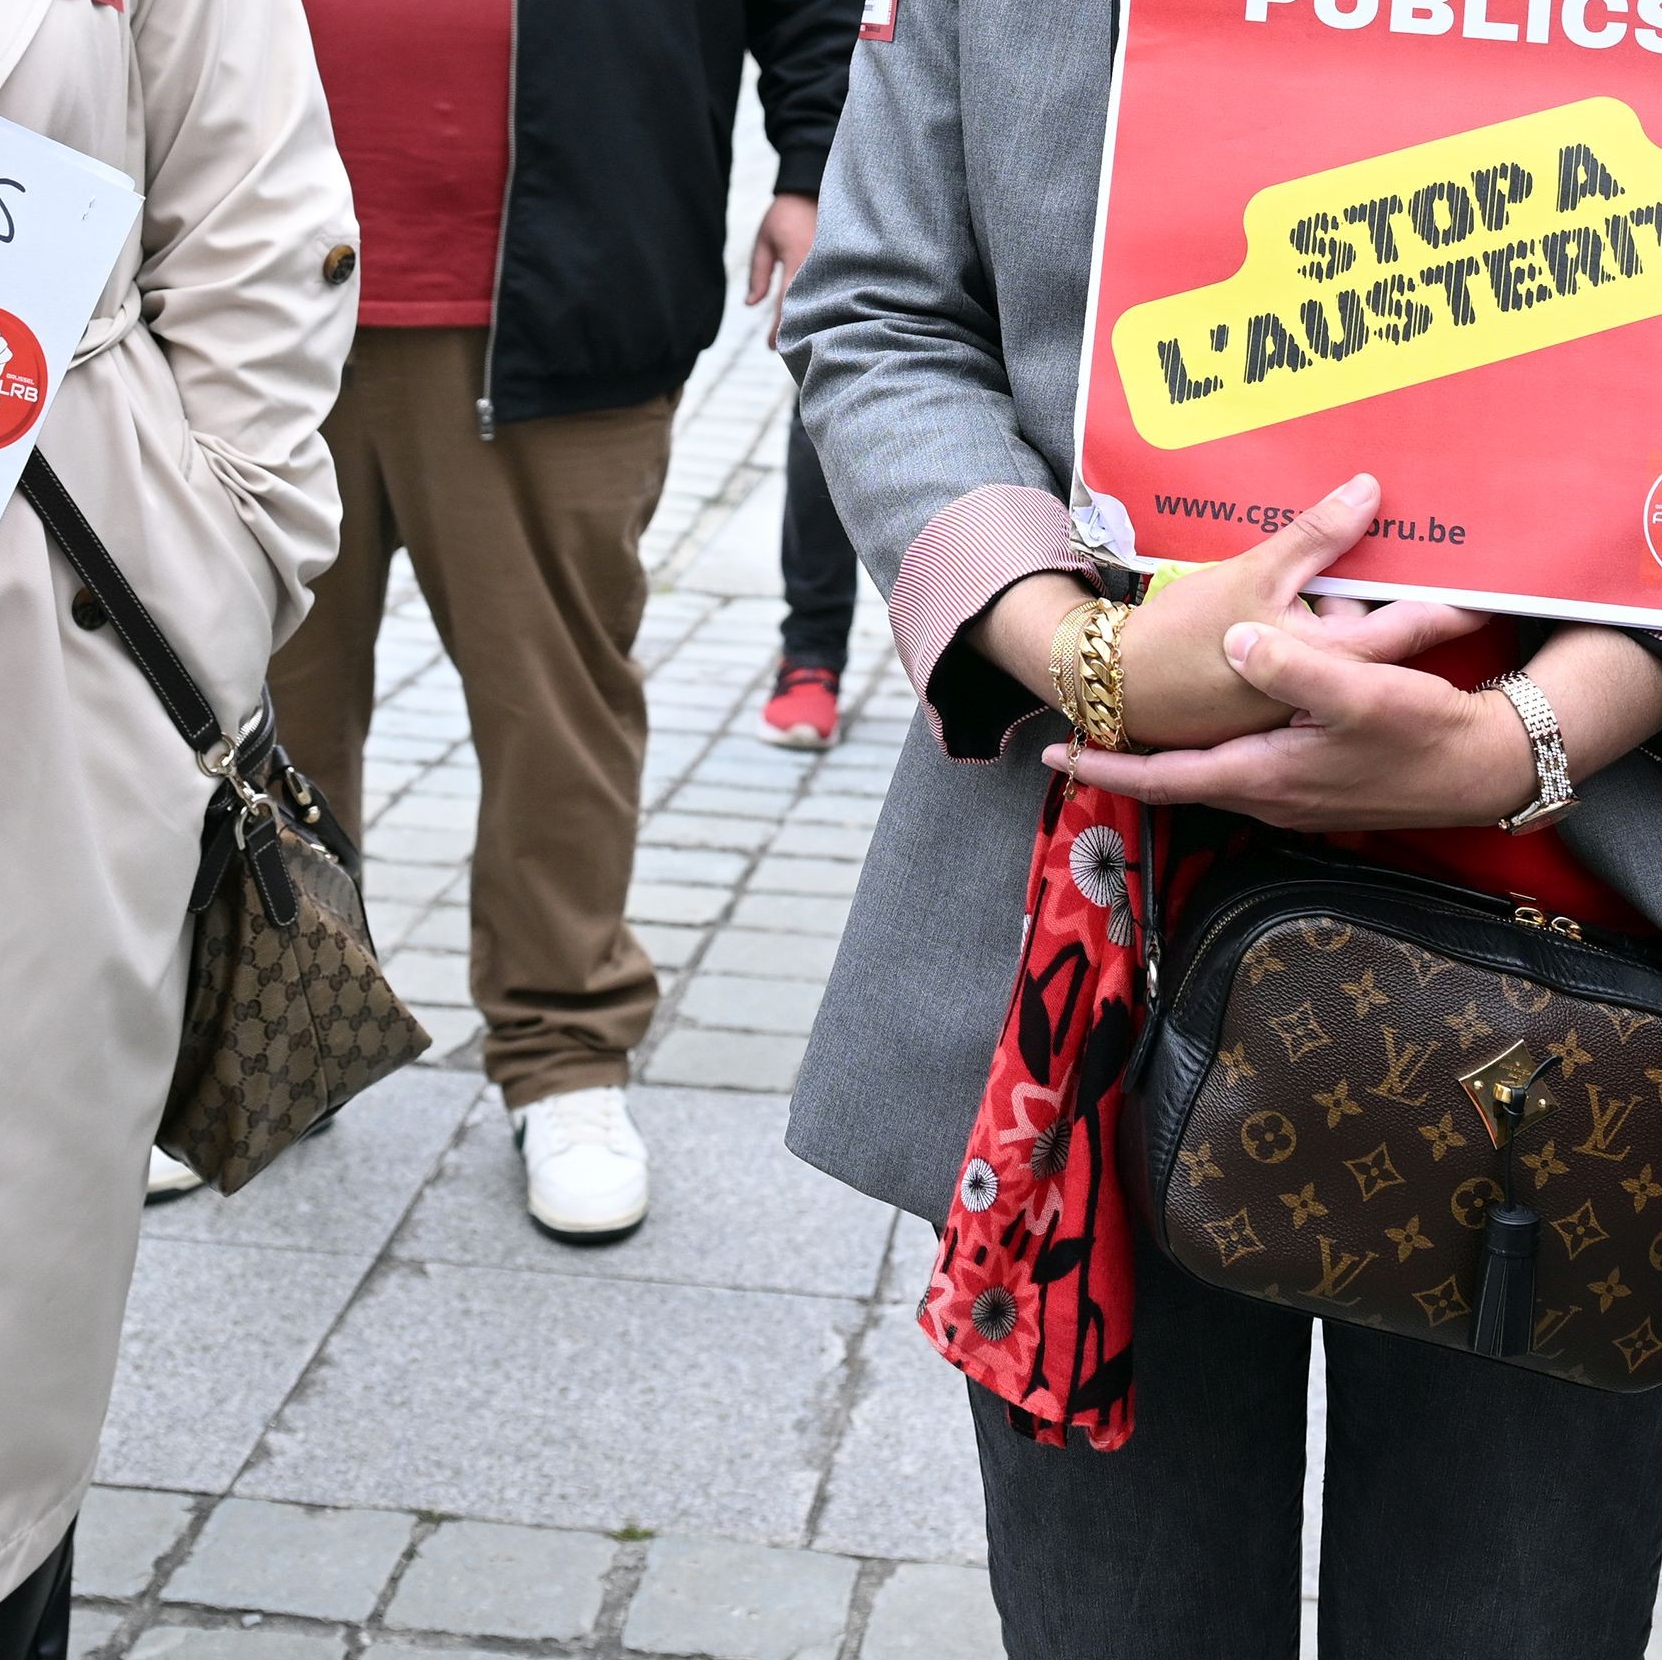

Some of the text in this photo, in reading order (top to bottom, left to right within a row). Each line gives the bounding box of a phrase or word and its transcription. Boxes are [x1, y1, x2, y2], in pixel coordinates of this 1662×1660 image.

[1289, 142, 1626, 284] STOP A
[6, 373, 35, 385] BRUSSEL
